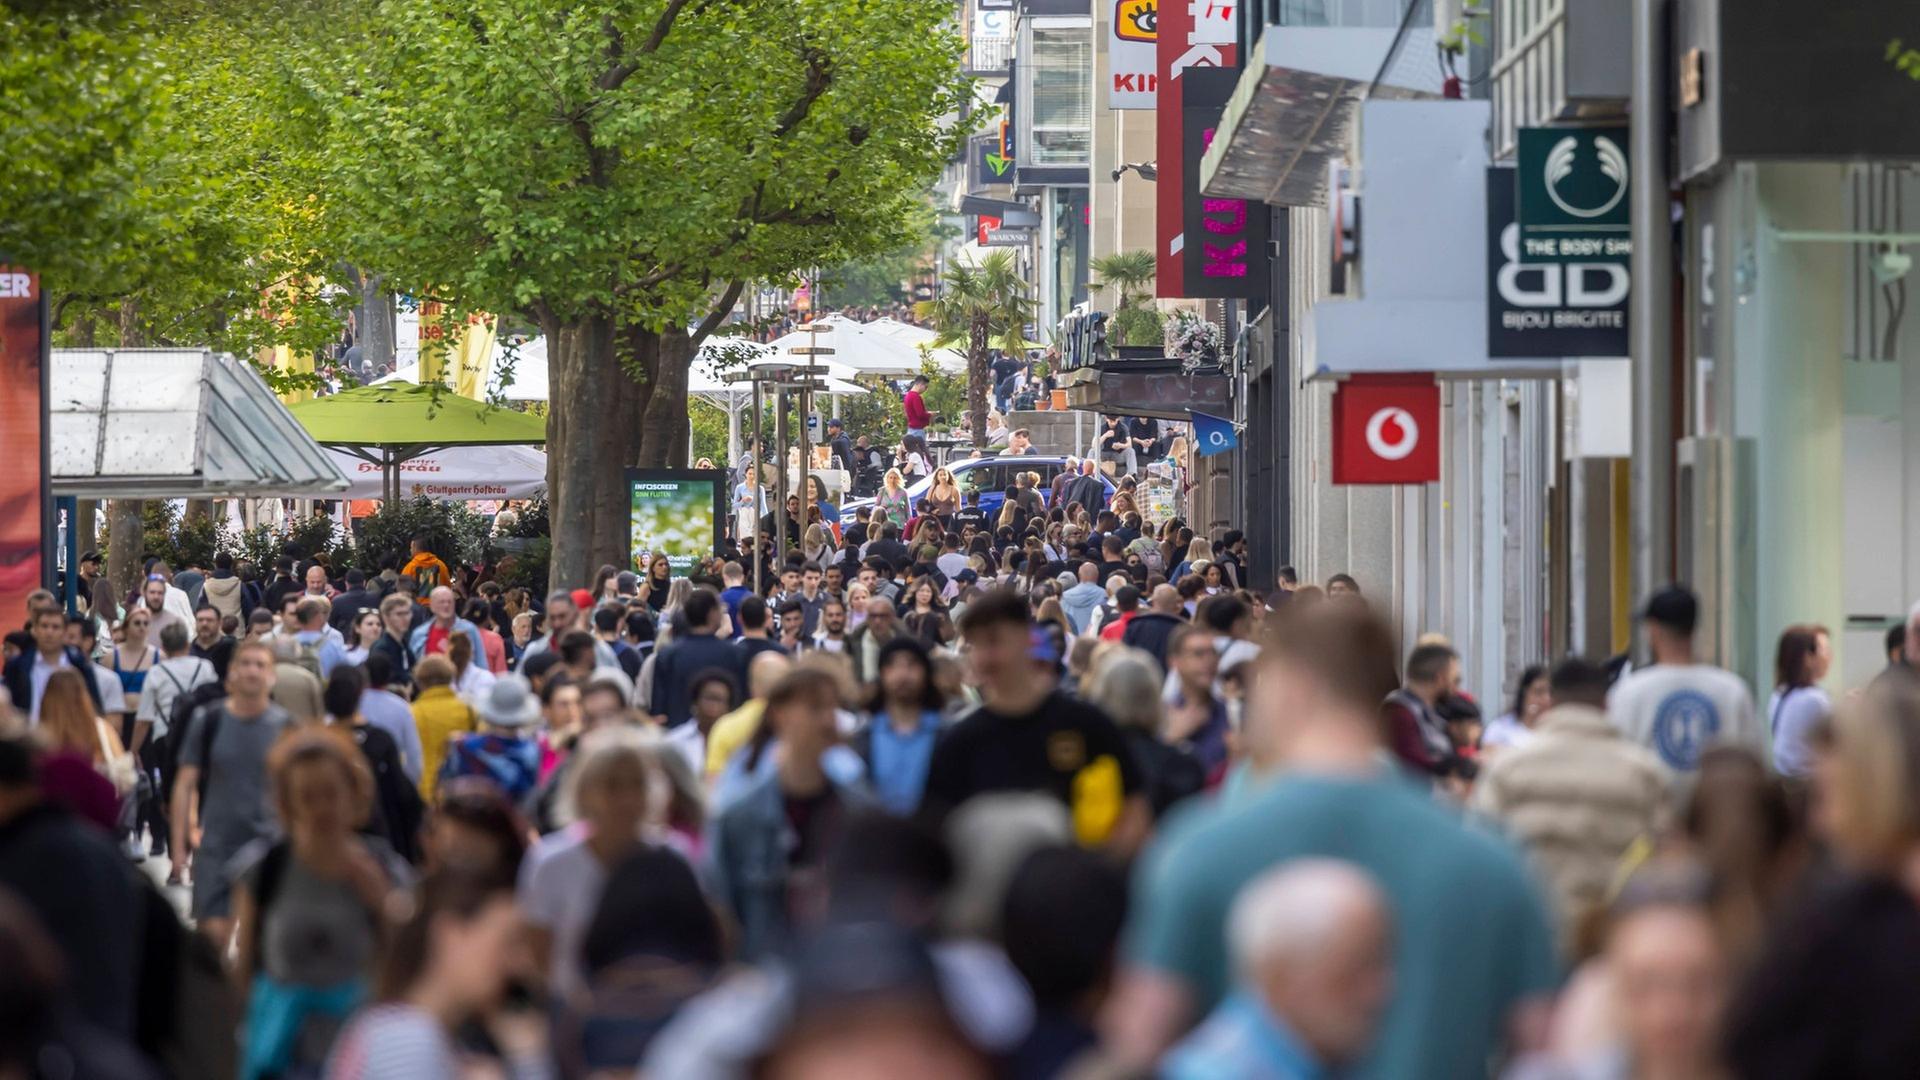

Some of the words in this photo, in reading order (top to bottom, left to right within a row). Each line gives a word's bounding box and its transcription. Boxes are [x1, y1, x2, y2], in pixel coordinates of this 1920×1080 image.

[1525, 238, 1556, 256] THE
[1559, 238, 1604, 256] BODY
[1502, 310, 1549, 331] BIJOU
[1553, 310, 1625, 328] BRIGITTE
[426, 485, 471, 495] Stuttgarter
[473, 484, 507, 495] Hofbräu
[634, 483, 679, 491] INFOSCREEN
